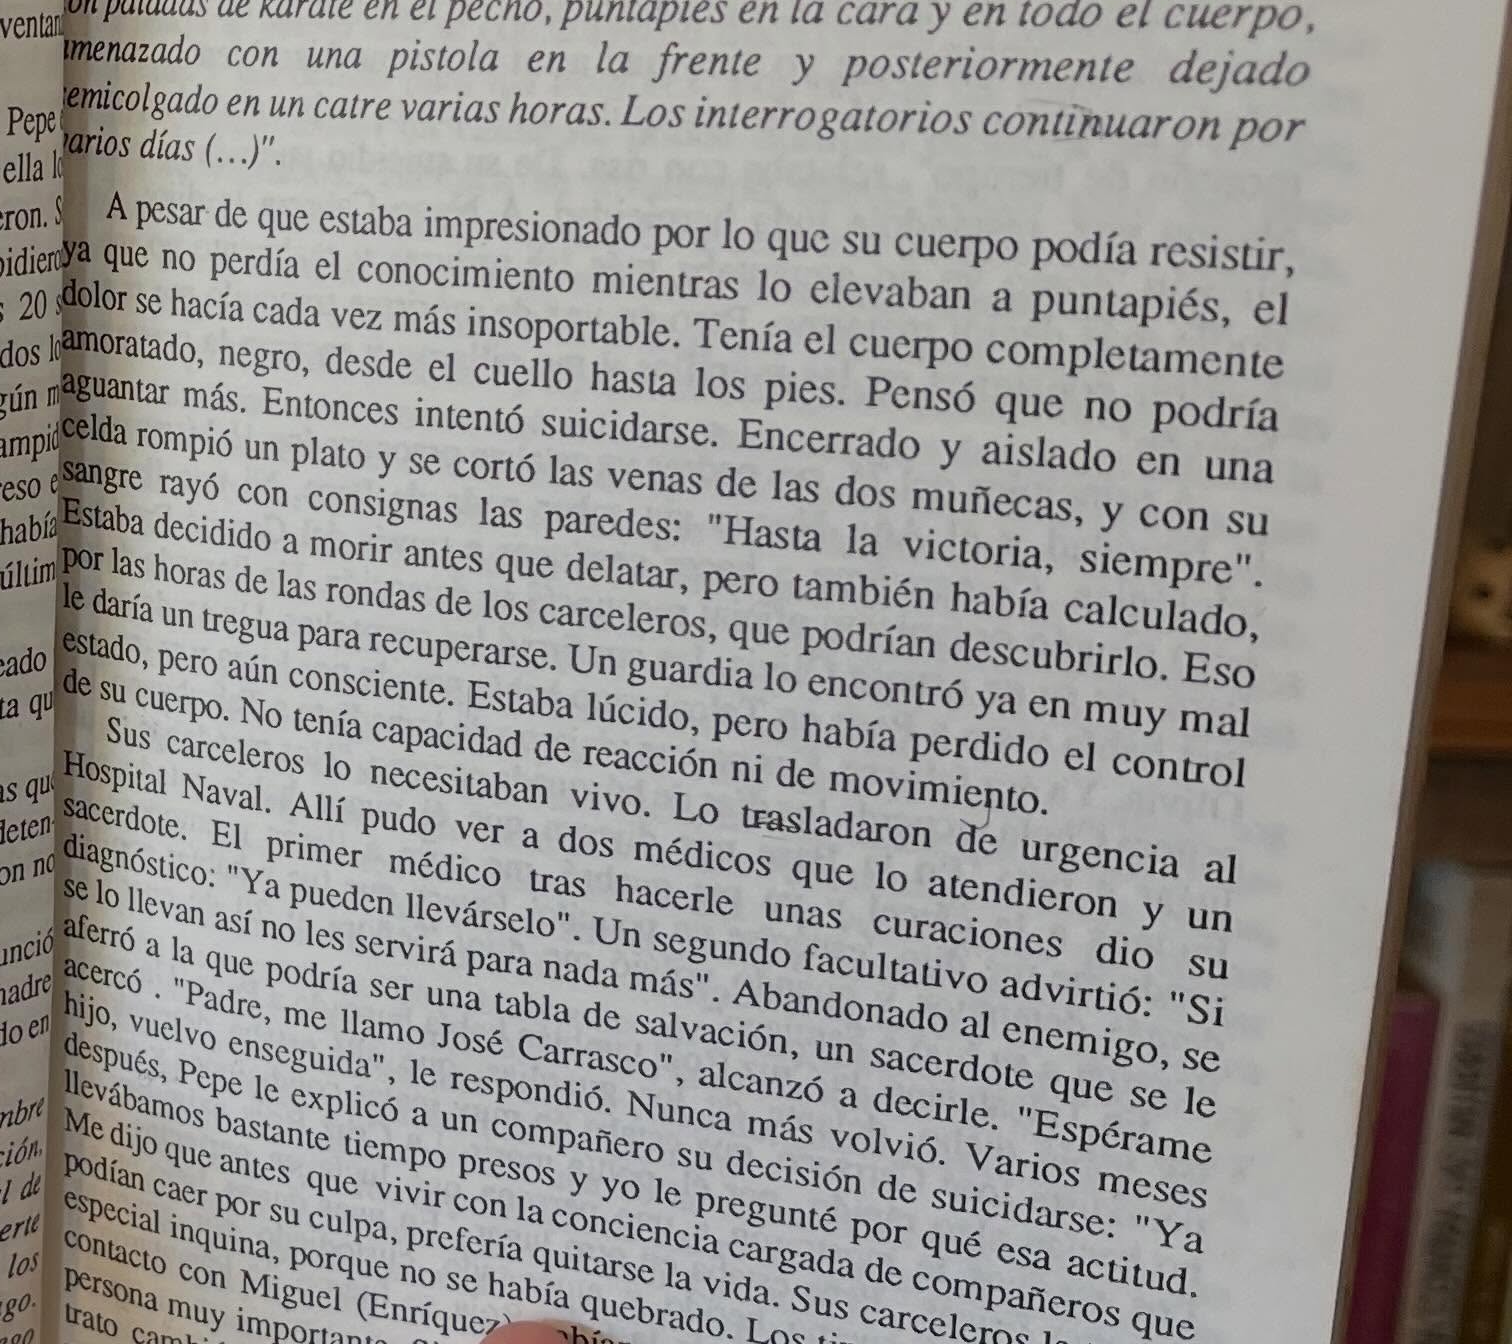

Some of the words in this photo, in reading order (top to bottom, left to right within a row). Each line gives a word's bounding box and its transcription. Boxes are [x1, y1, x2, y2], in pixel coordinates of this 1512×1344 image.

[739, 0, 778, 24] en
[837, 2, 918, 25] cara
[928, 3, 950, 34] y
[963, 3, 1005, 26] en
[1165, 4, 1313, 39] cuerpo,
[140, 129, 195, 161] días
[206, 133, 280, 170] (...)".
[63, 240, 91, 268] ya
[104, 244, 148, 272] que
[162, 249, 195, 271] no
[211, 248, 299, 281] perdía
[316, 251, 340, 280] el
[358, 256, 574, 292] conocimiento
[593, 264, 738, 299] mientras
[758, 269, 791, 302] lo
[811, 272, 970, 309] elevaban
[992, 288, 1012, 312] a
[1031, 286, 1230, 328] puntapiés,
[1254, 292, 1288, 325] el
[0, 510, 57, 546] había
[62, 459, 144, 496] sangre
[160, 472, 219, 505] rayó
[238, 484, 288, 507] con
[309, 488, 457, 526] consignas
[480, 497, 522, 528] las
[544, 508, 680, 541] paredes:
[709, 514, 821, 552] "Hasta
[847, 523, 878, 556] la
[903, 529, 1053, 575] victoria,
[1080, 542, 1262, 589] siempre".
[62, 668, 93, 698] de
[101, 681, 125, 703] su
[136, 688, 229, 723] cuerpo.
[241, 697, 282, 728] No
[294, 709, 362, 739] tenía
[373, 722, 522, 759] capacidad
[535, 733, 571, 763] de
[583, 746, 717, 778] reacción
[732, 755, 762, 783] ni
[776, 758, 815, 789] de
[828, 769, 1049, 816] movimiento.
[64, 833, 215, 887] diagnóstico:
[228, 864, 280, 899] "Ya
[290, 883, 393, 916] pueden
[406, 893, 580, 941] llevárselo".
[593, 916, 640, 948] Un
[654, 932, 791, 967] segundo
[803, 943, 988, 994] facultativo
[1000, 973, 1151, 1016] advirtió:
[1171, 991, 1223, 1027] "Si
